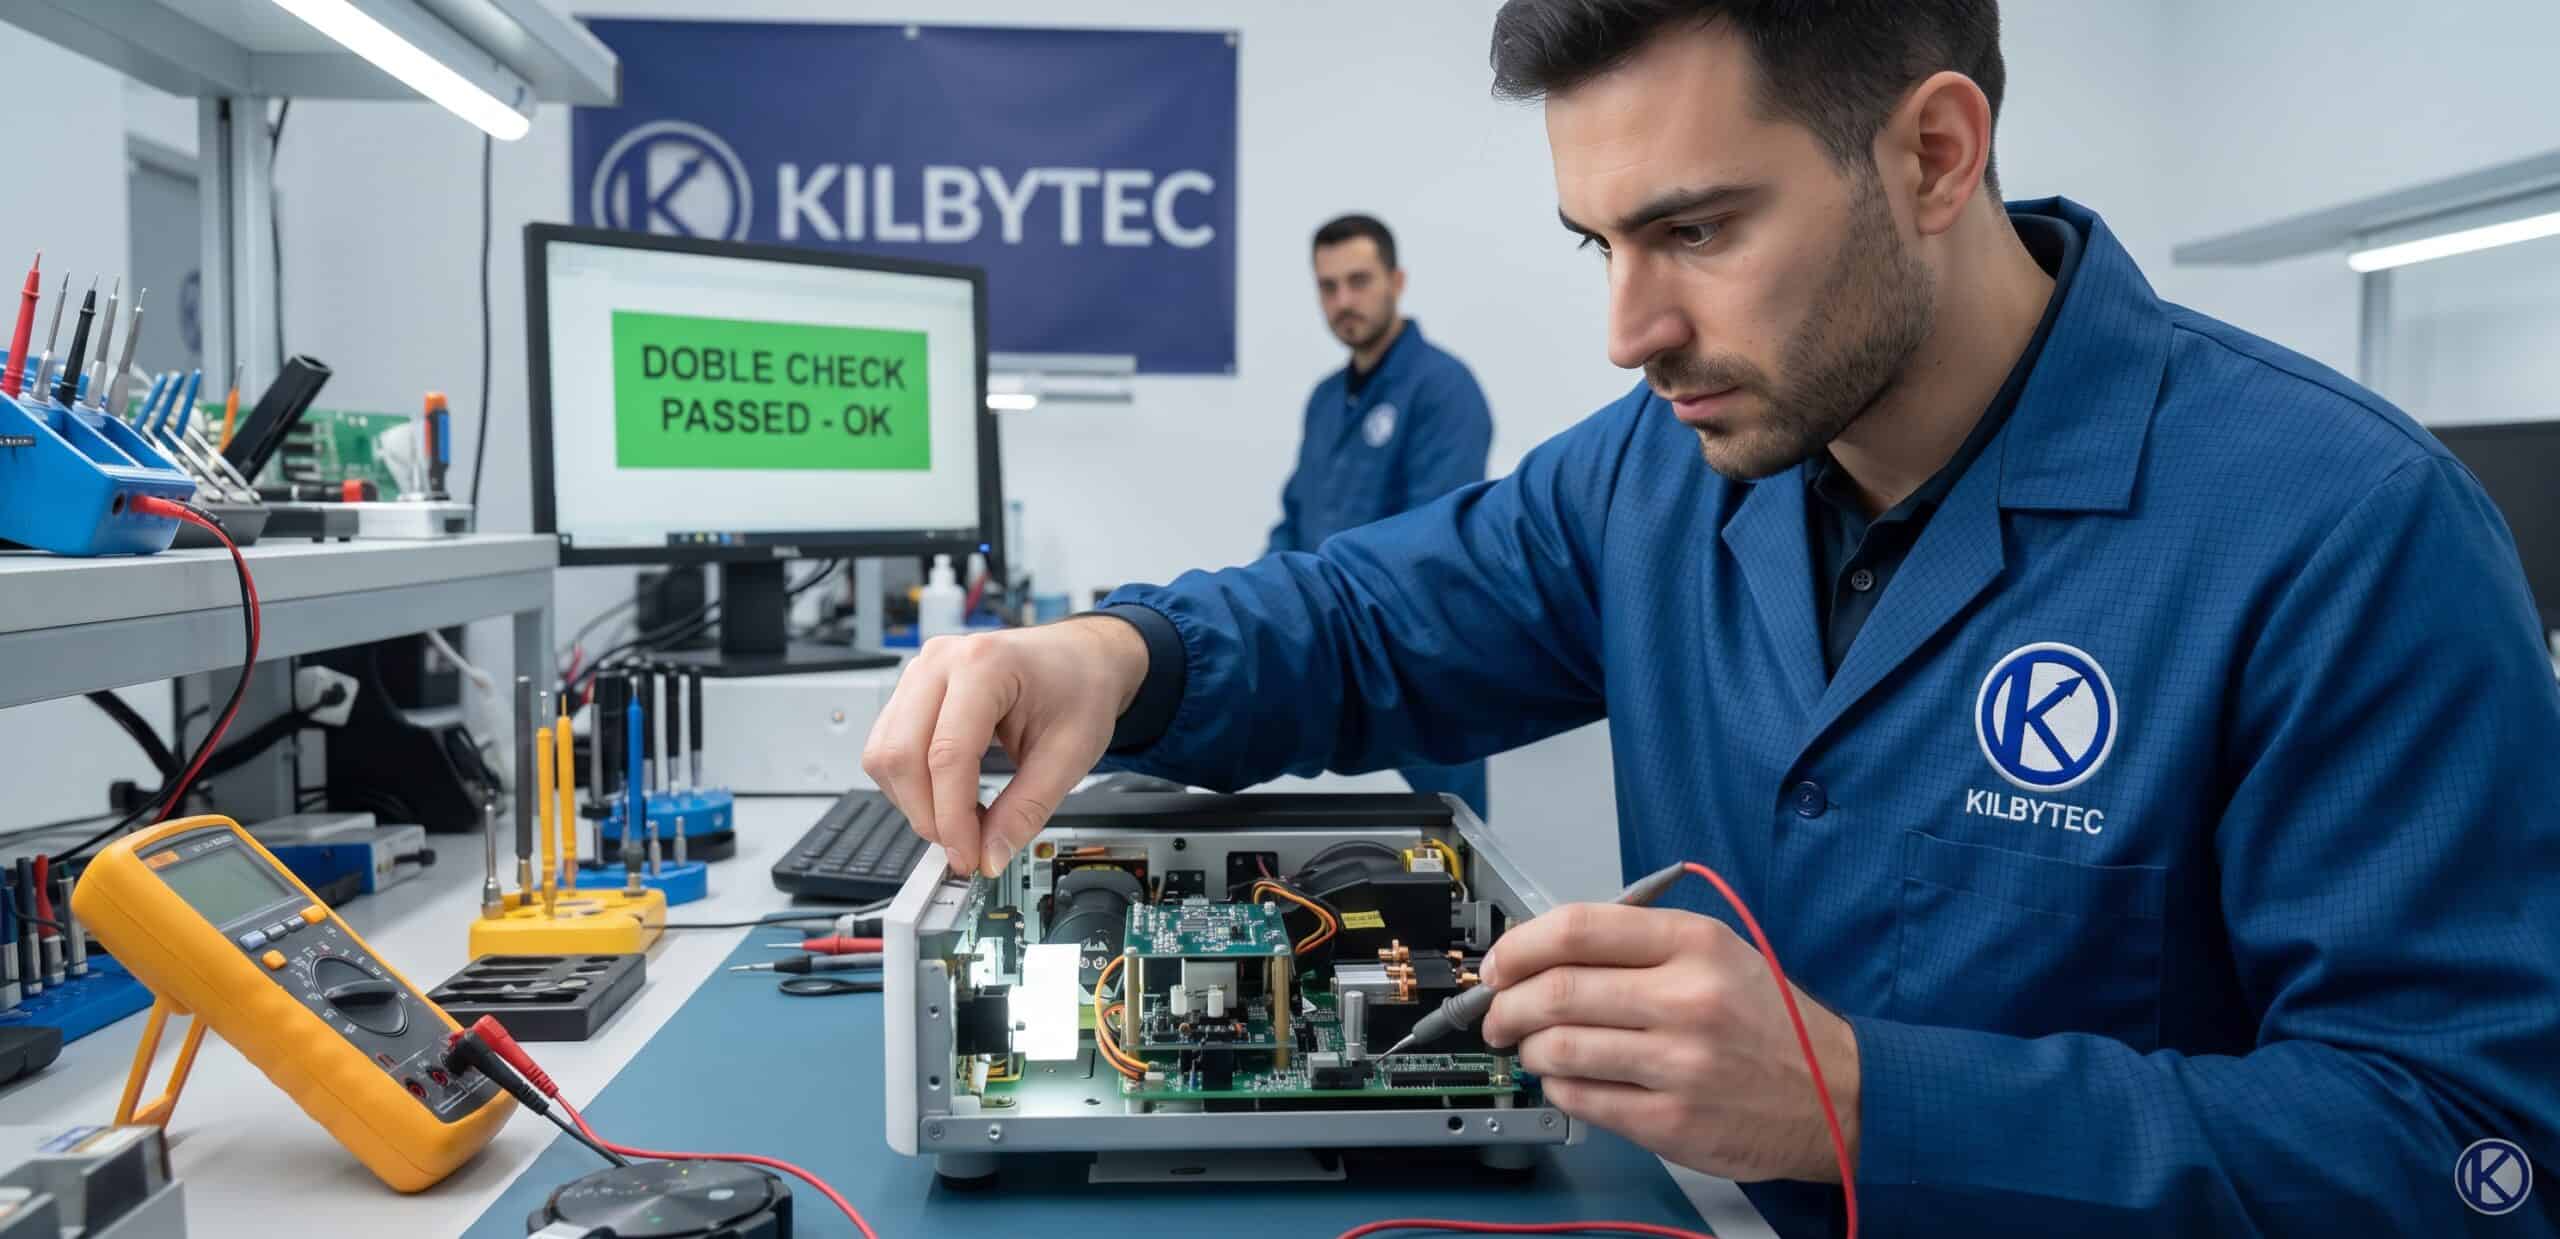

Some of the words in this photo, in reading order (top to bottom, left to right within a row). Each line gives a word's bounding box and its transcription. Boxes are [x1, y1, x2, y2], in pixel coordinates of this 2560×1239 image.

[777, 162, 1216, 249] KILBYTEC
[641, 344, 775, 384] DOBLE
[786, 352, 906, 390] CHECK
[661, 397, 812, 435] PASSED
[842, 403, 893, 437] OK
[1965, 787, 2105, 835] KILBYTEC
